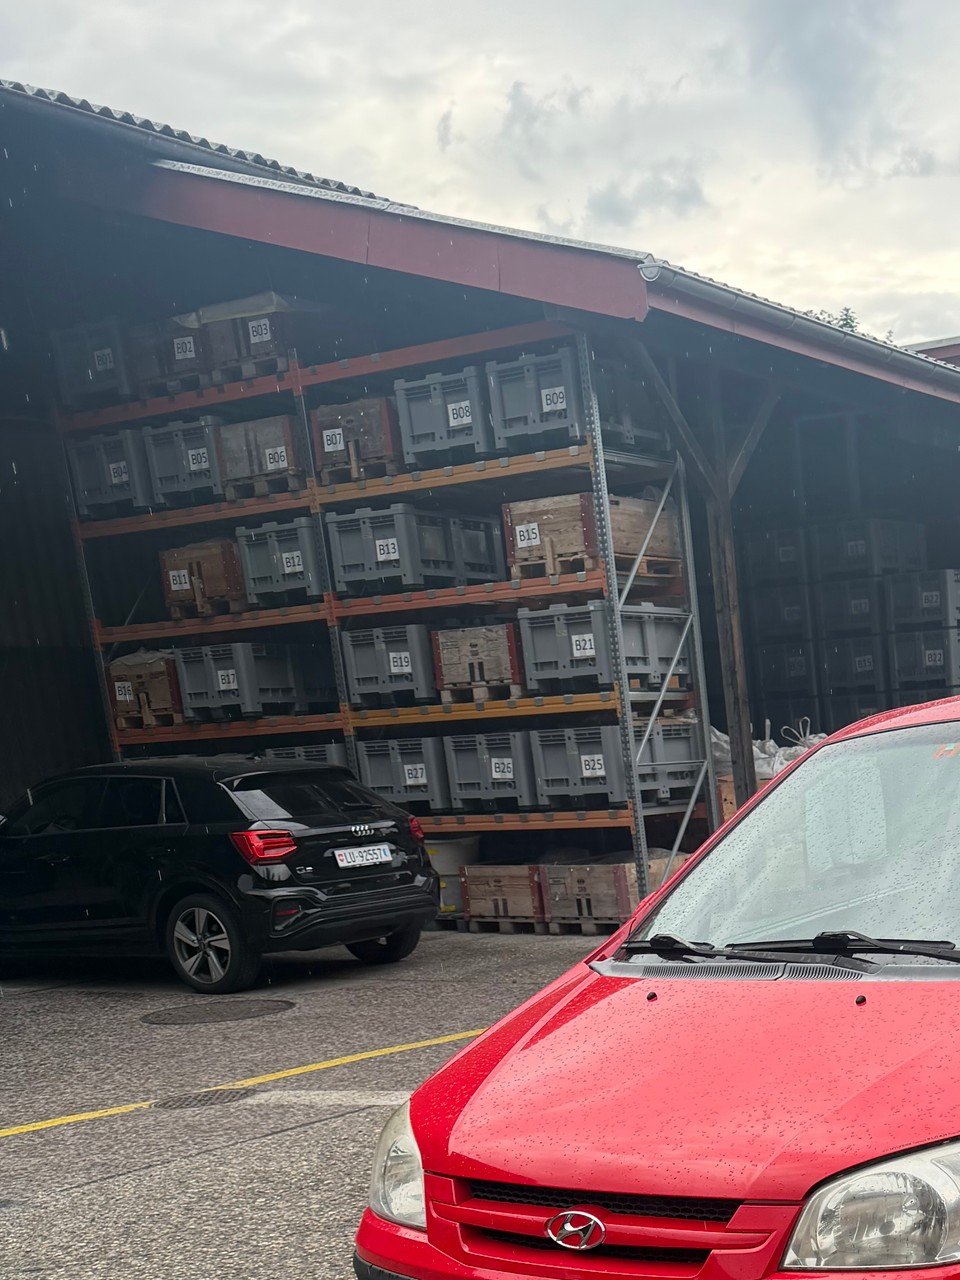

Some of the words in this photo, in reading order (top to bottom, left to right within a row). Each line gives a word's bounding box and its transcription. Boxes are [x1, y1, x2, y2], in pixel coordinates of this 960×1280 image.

[251, 323, 269, 338] B03
[176, 341, 193, 355] B02
[545, 391, 565, 406] B09
[451, 405, 471, 420] B08
[326, 432, 342, 447] B07
[191, 452, 208, 465] B05
[268, 450, 286, 464] B06
[112, 464, 128, 478] B04
[519, 528, 538, 542] B15
[378, 543, 397, 556] B13
[285, 555, 302, 567] B12
[171, 573, 188, 586] B11
[575, 638, 595, 651] B21
[392, 656, 410, 668] B19
[927, 653, 943, 663] B22
[220, 673, 236, 685] B17
[494, 761, 512, 774] B26
[584, 758, 603, 771] B25
[407, 767, 424, 780] B27
